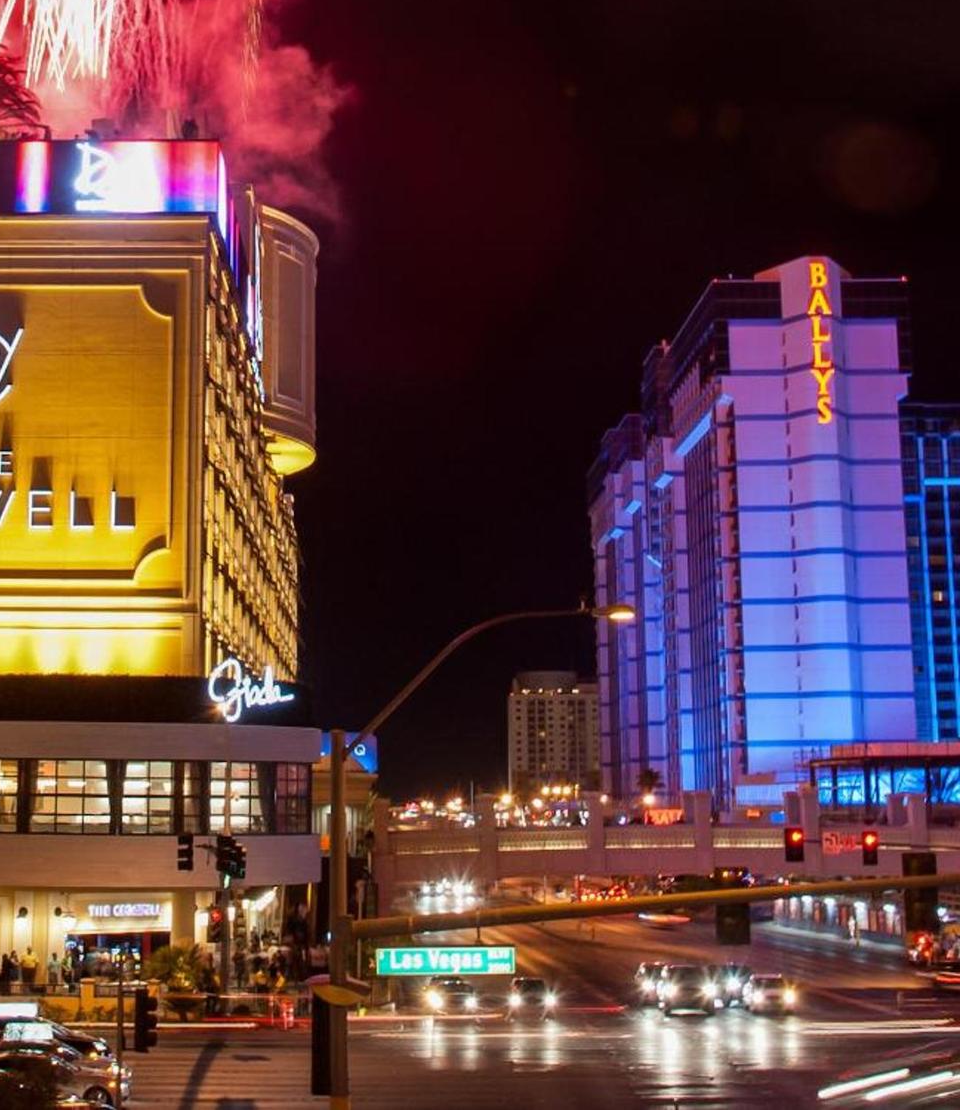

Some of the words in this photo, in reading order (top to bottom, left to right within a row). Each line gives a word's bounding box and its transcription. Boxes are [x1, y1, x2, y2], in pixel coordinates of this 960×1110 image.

[208, 657, 295, 723] Giada
[390, 948, 423, 969] Las
[427, 948, 483, 974] Vegas
